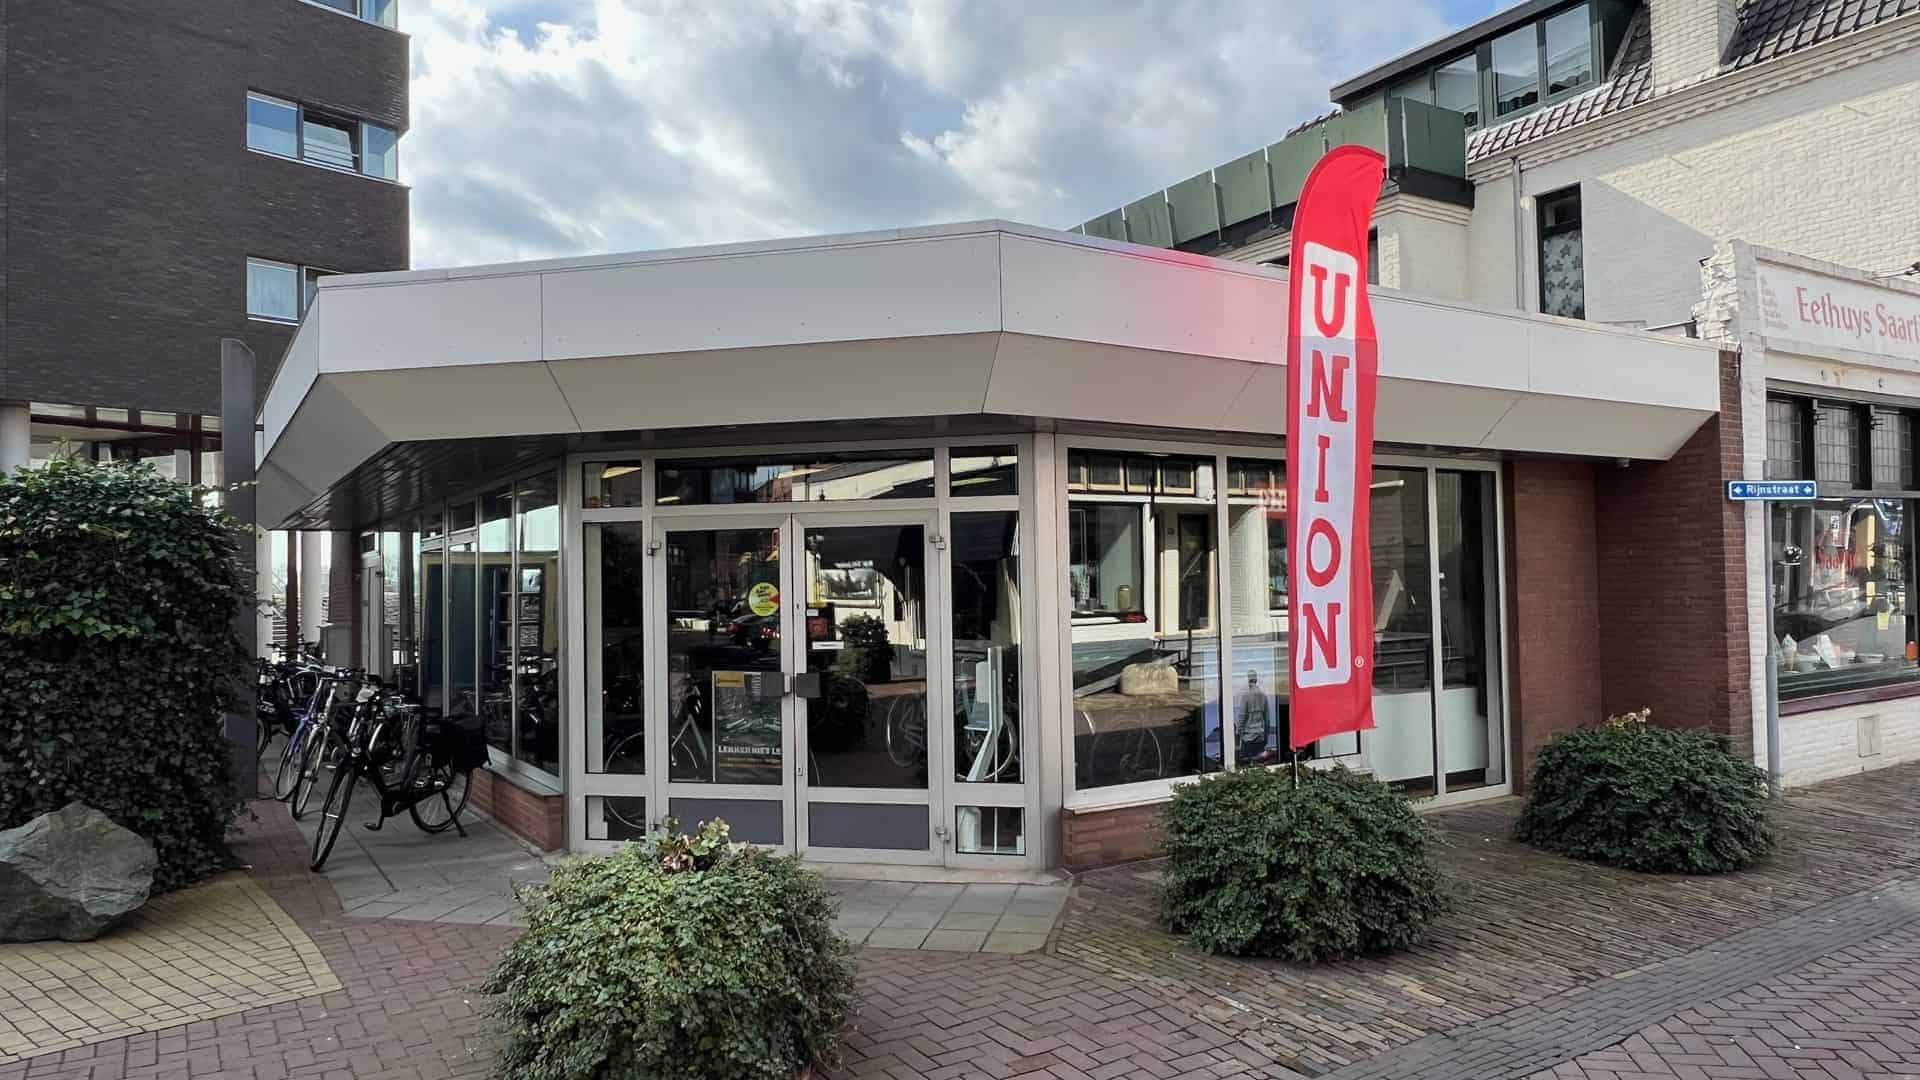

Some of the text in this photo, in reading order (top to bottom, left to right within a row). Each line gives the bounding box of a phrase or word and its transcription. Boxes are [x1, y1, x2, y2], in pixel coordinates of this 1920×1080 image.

[1796, 286, 1872, 339] Eethuys
[1303, 264, 1350, 671] UNION
[1746, 485, 1800, 496] Rijnstraat
